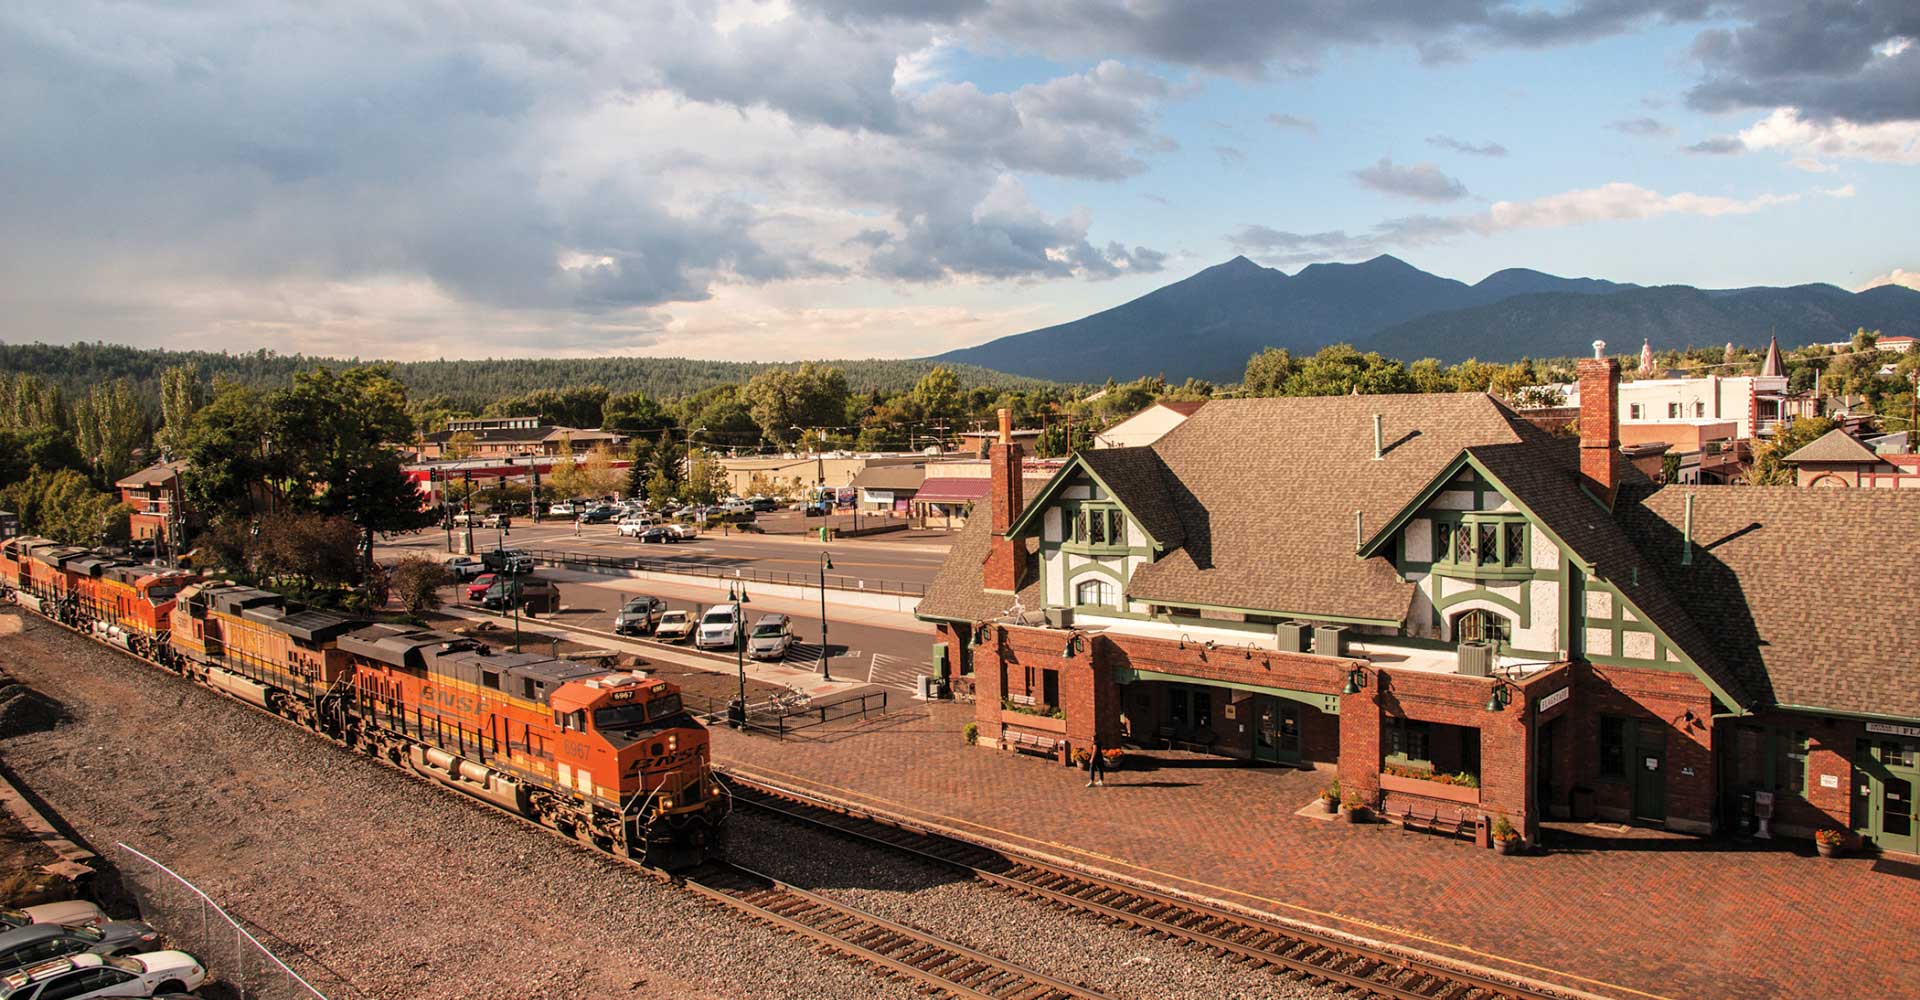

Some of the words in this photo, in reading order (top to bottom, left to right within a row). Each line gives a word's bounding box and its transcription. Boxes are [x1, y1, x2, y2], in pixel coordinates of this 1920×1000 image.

[422, 685, 488, 715] BNSF
[614, 691, 633, 700] 6967
[564, 739, 591, 761] 6967
